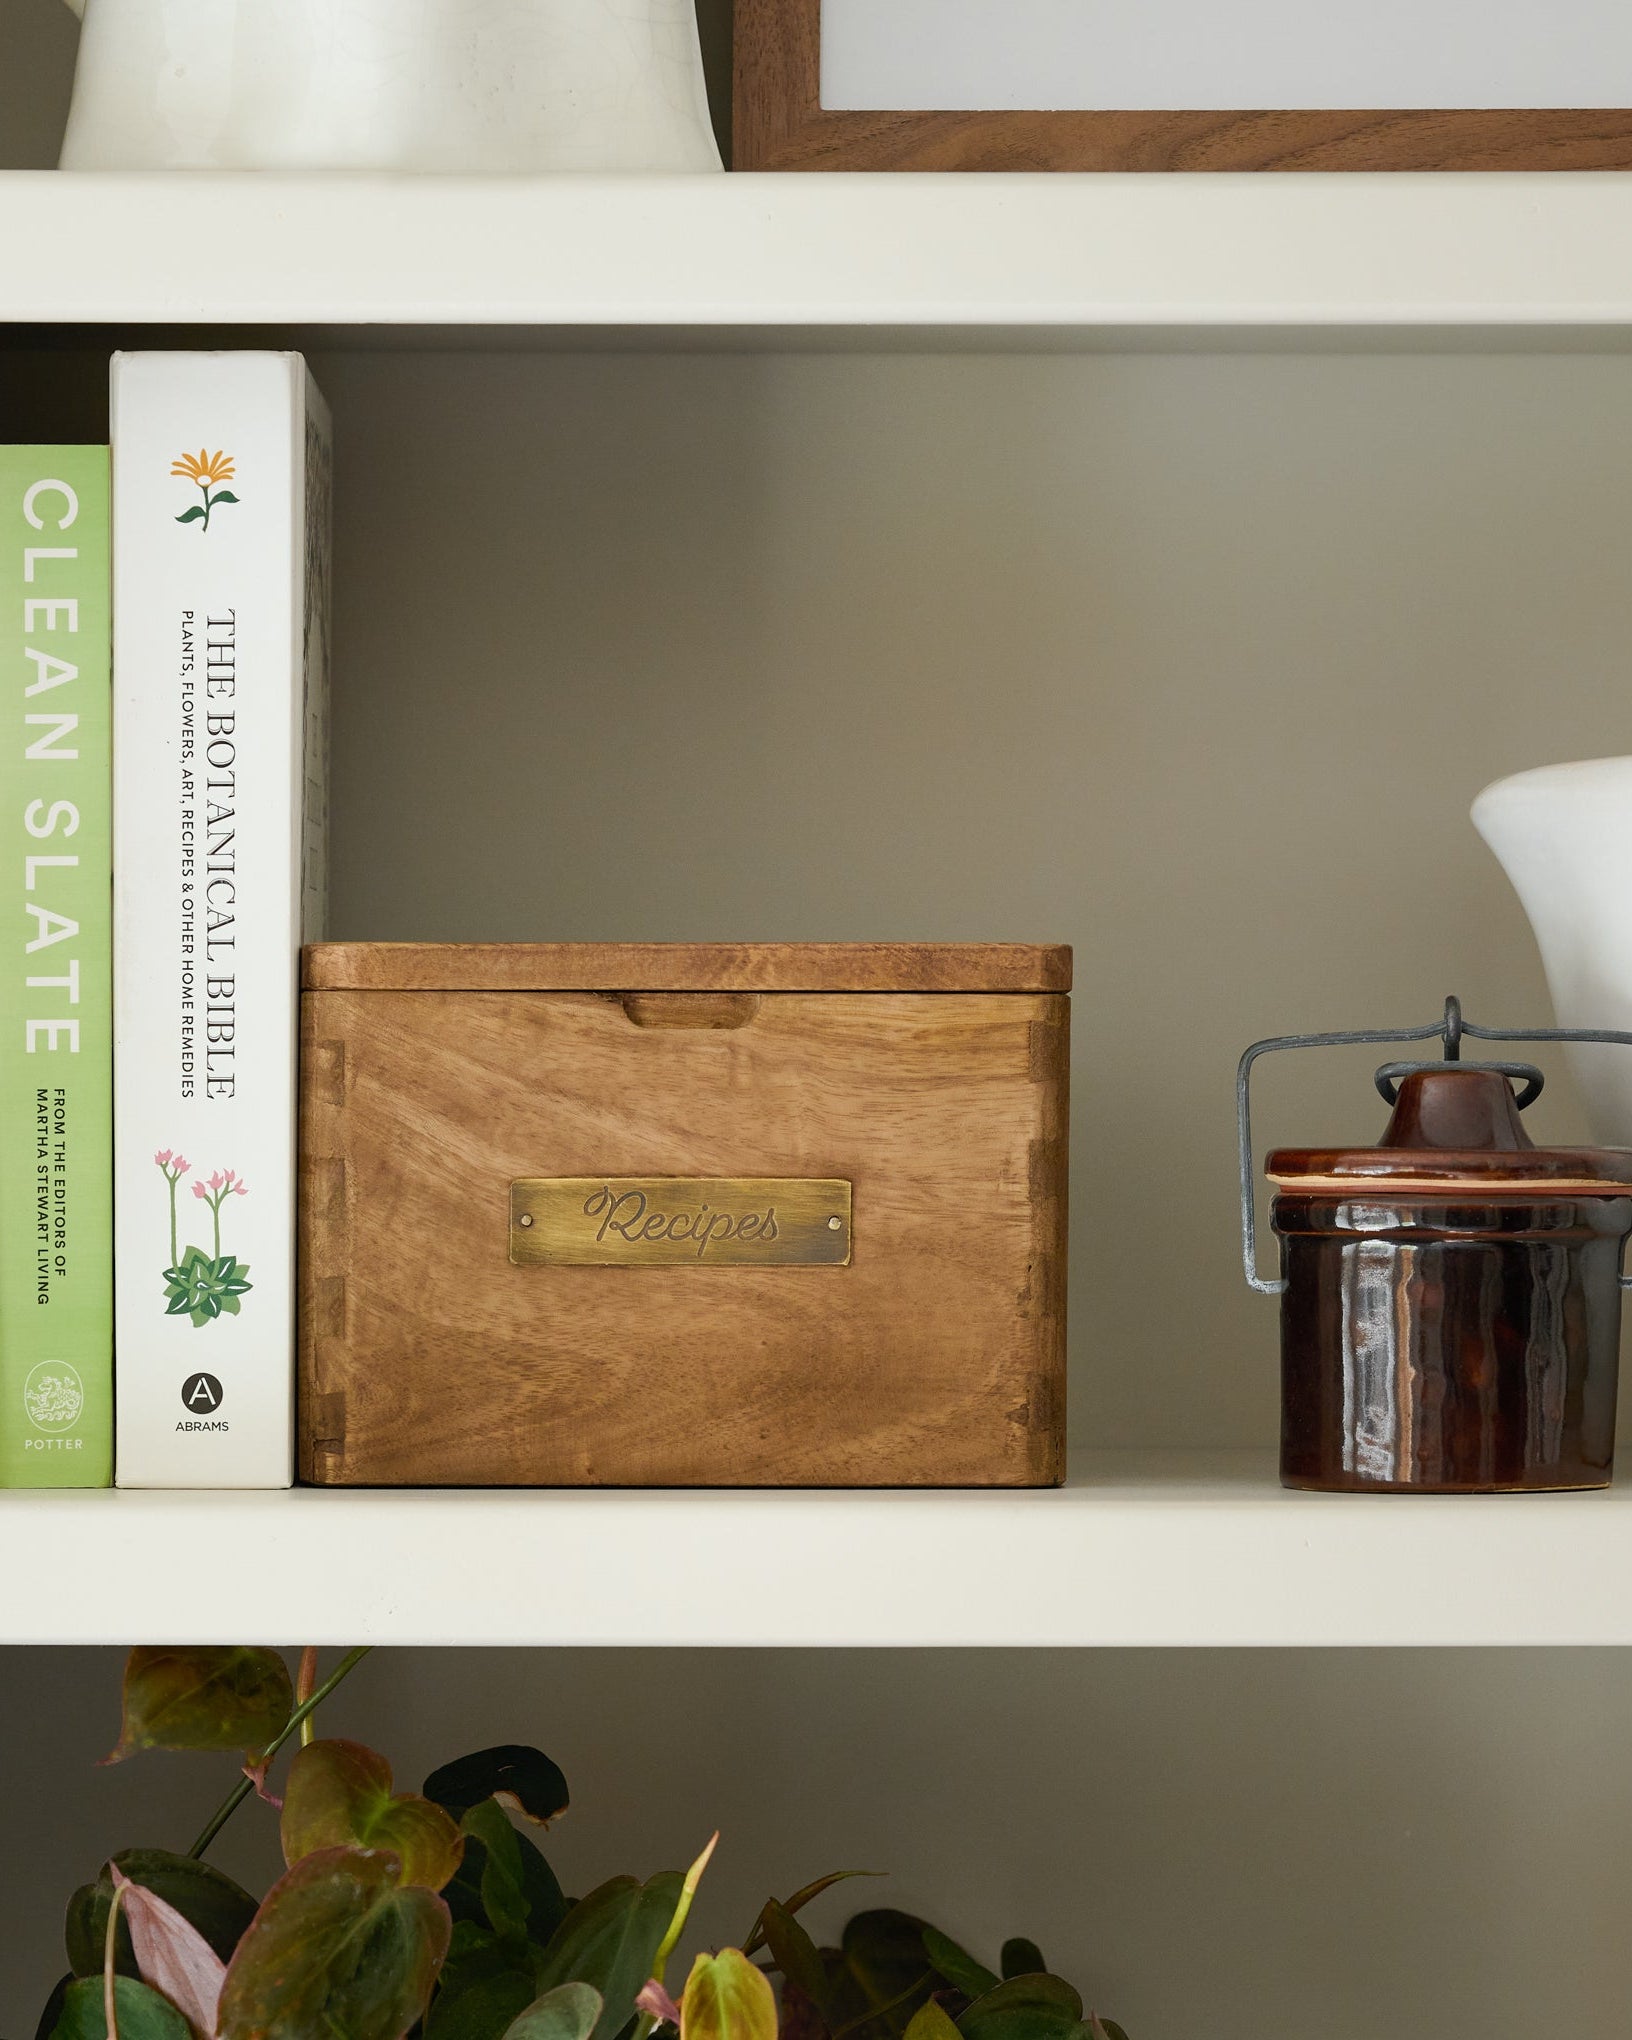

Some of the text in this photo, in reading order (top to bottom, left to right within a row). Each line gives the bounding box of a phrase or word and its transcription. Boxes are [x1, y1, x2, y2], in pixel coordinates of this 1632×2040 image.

[23, 479, 81, 1054] CLEAN SLATE
[180, 610, 194, 1098] PLANTS, FLOWERS, ART, RECIPES & OTHER HOME REMEDIES
[206, 608, 236, 1100] THE BOTANICAL BIBLE
[37, 1088, 50, 1305] MARTHA STEWART LIVING
[54, 1088, 66, 1277] FROM THE EDITORS OF
[582, 1185, 780, 1258] Recipes
[24, 1439, 83, 1450] POTTER
[175, 1421, 229, 1432] ABRAMS
[188, 1377, 216, 1406] A
